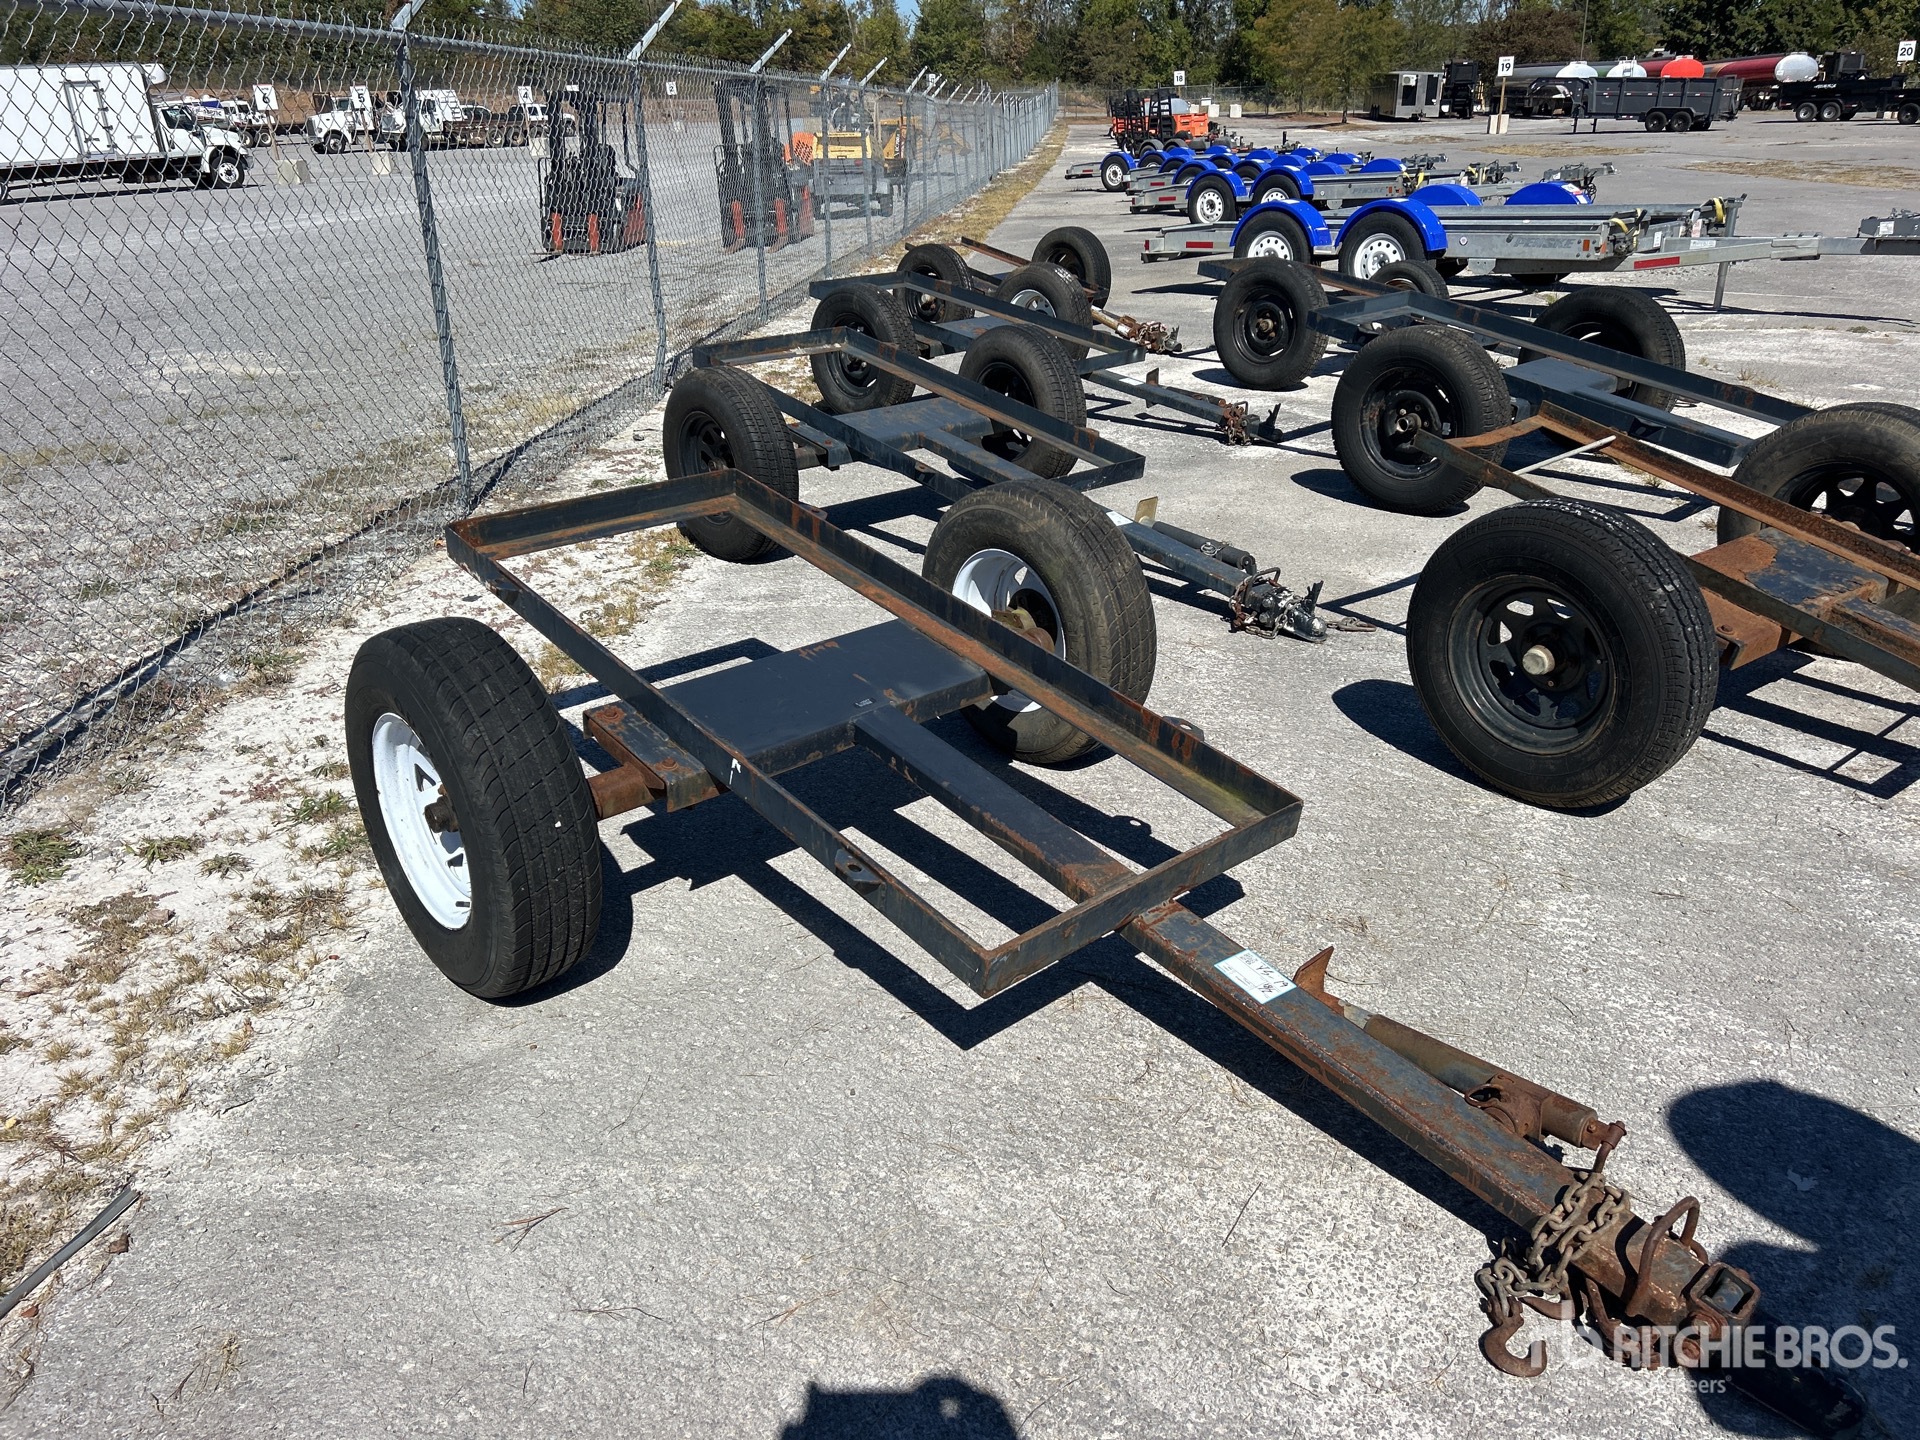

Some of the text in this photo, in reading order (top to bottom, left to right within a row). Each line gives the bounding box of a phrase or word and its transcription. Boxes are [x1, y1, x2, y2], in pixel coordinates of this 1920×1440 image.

[1900, 47, 1913, 56] 20
[1501, 63, 1511, 72] 19
[263, 93, 270, 104] 6
[358, 93, 365, 103] 5
[1513, 238, 1576, 249] PENSKE
